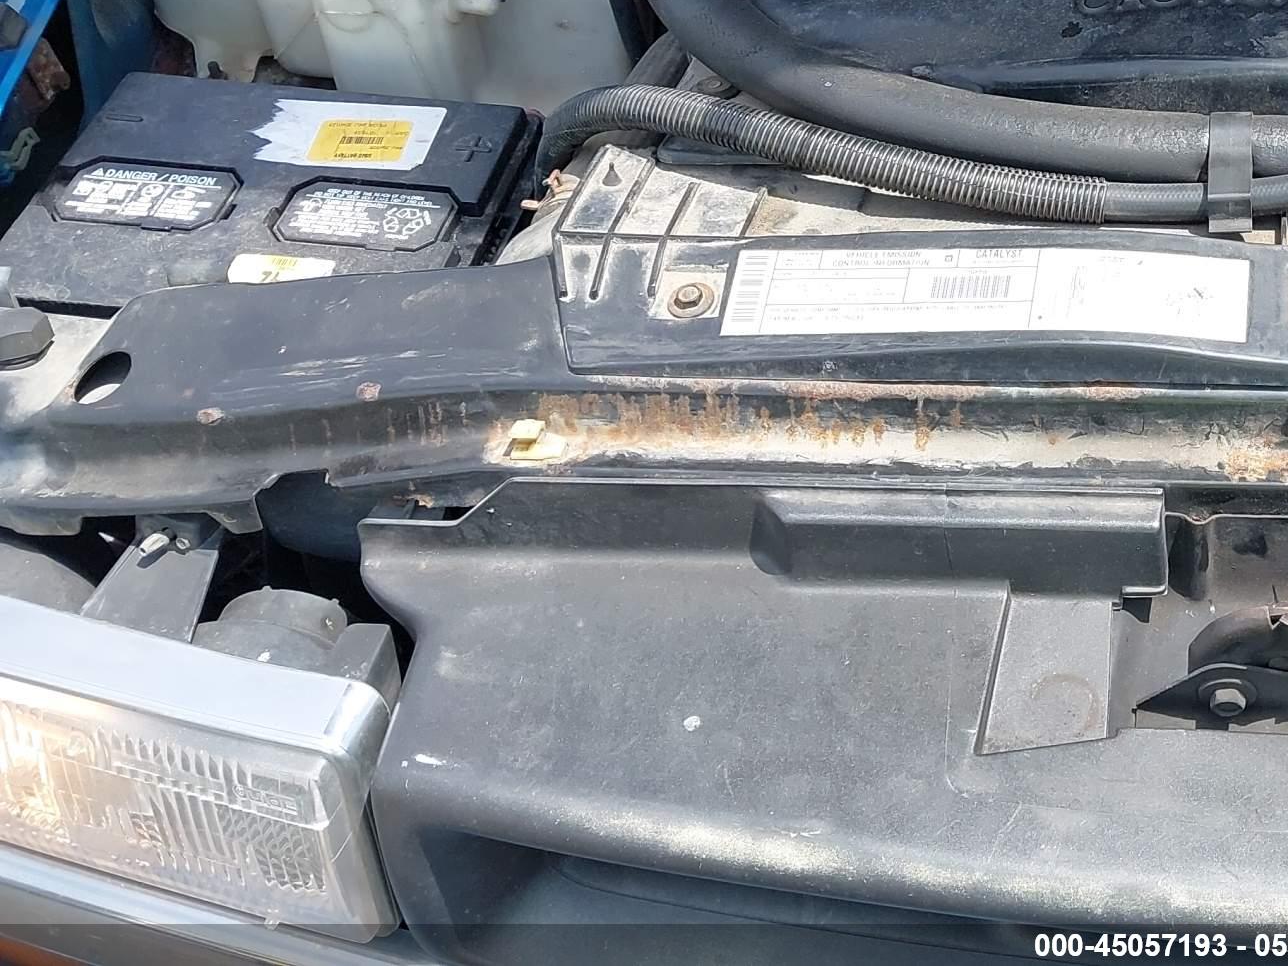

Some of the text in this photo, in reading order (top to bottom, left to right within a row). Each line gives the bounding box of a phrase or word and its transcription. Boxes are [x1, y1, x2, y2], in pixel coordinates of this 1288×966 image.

[102, 168, 157, 182] DANGER
[168, 174, 218, 186] POISON
[975, 249, 1023, 259] CATALYST
